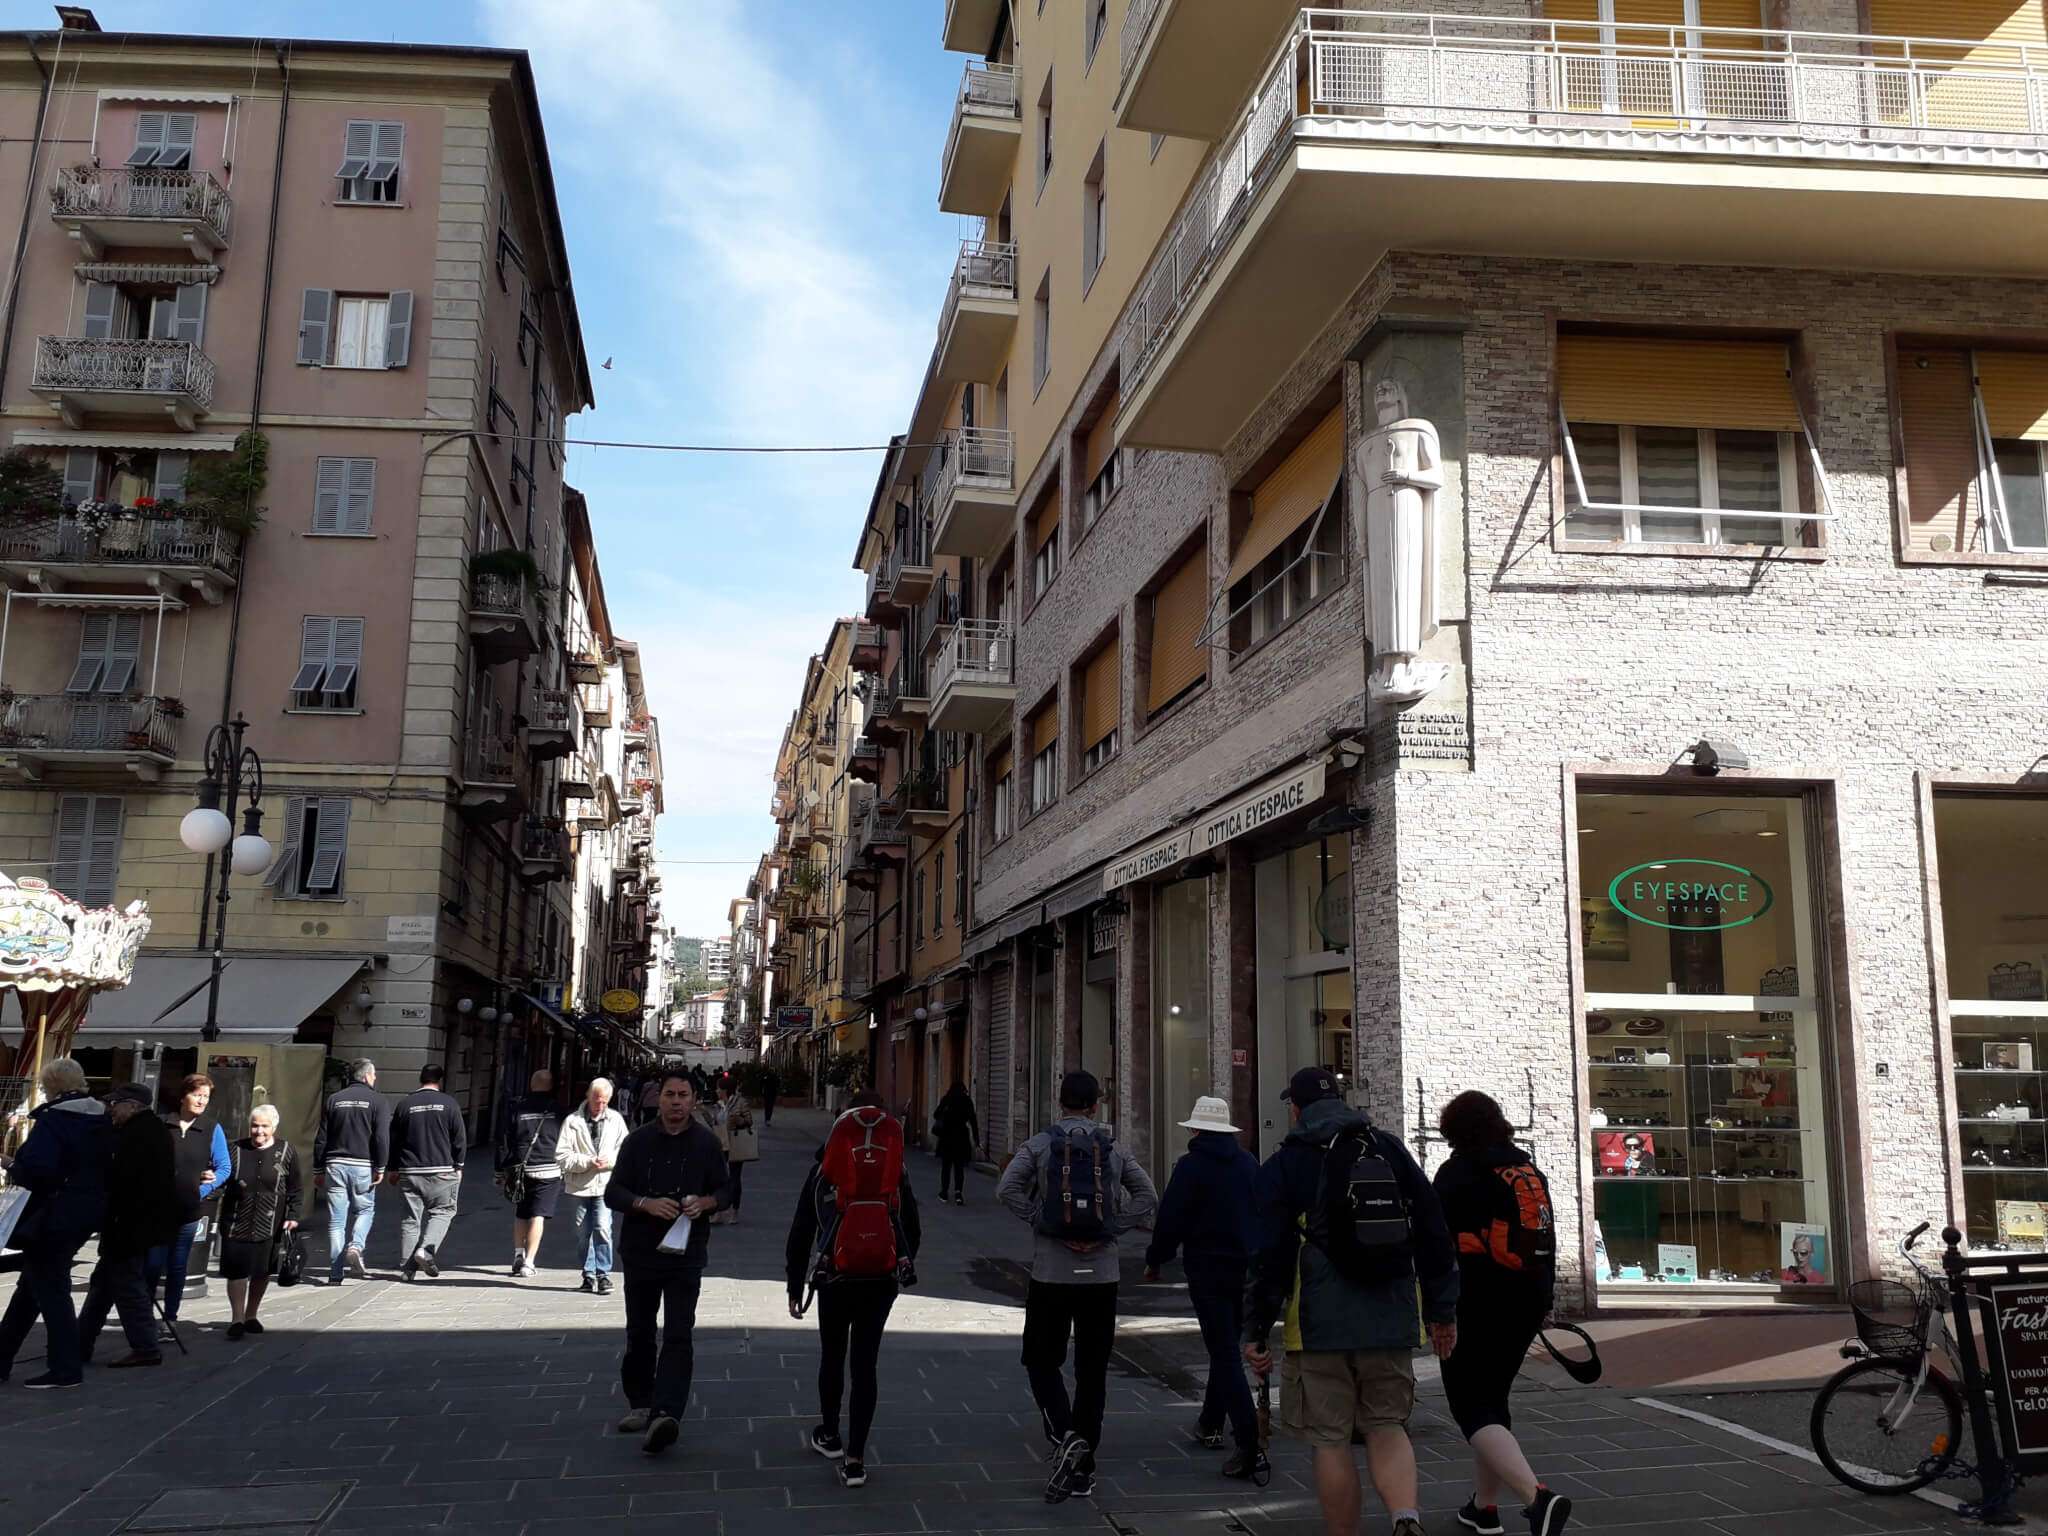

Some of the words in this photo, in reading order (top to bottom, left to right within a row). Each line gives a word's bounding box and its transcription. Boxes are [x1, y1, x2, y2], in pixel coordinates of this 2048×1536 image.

[1207, 812, 1242, 845] OTTICA
[1245, 781, 1304, 829] EYESPACE
[1113, 860, 1138, 886] OTTICA
[1139, 842, 1178, 873] EYESPACE
[1633, 882, 1749, 902] EYESPACE
[1656, 905, 1728, 913] OTTICA
[2011, 1368, 2048, 1379] UOMO/
[2025, 1387, 2040, 1395] PER
